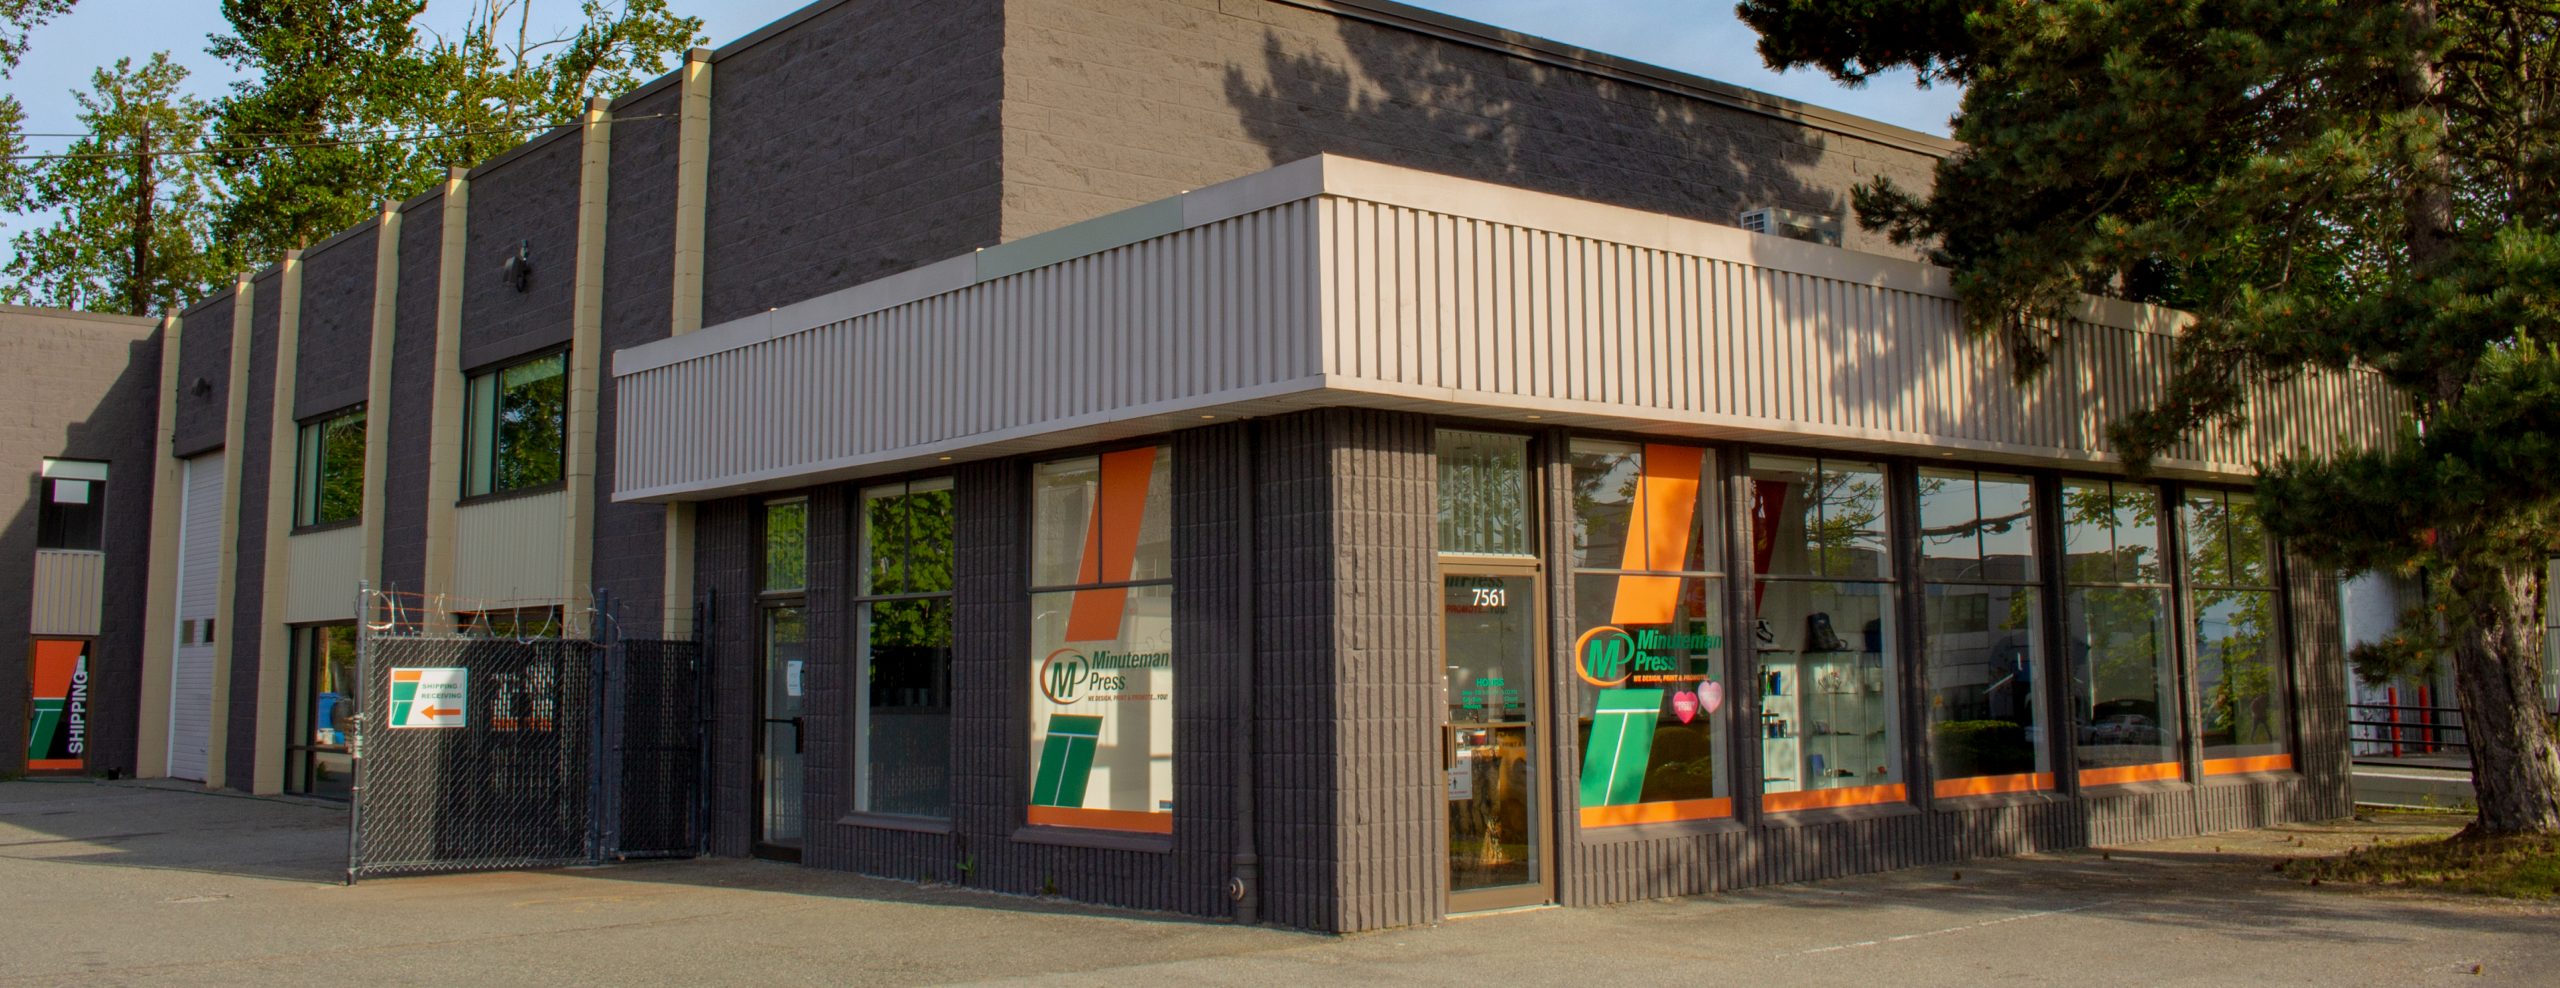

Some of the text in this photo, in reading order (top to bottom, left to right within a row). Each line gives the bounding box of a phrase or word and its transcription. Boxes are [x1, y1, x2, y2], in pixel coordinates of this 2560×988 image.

[1472, 589, 1505, 607] 7561
[1637, 629, 1722, 650] Minuteman
[1092, 651, 1170, 670] Minuteman
[1634, 651, 1677, 671] Press
[1089, 672, 1126, 691] Press
[68, 671, 88, 754] SHIPPING
